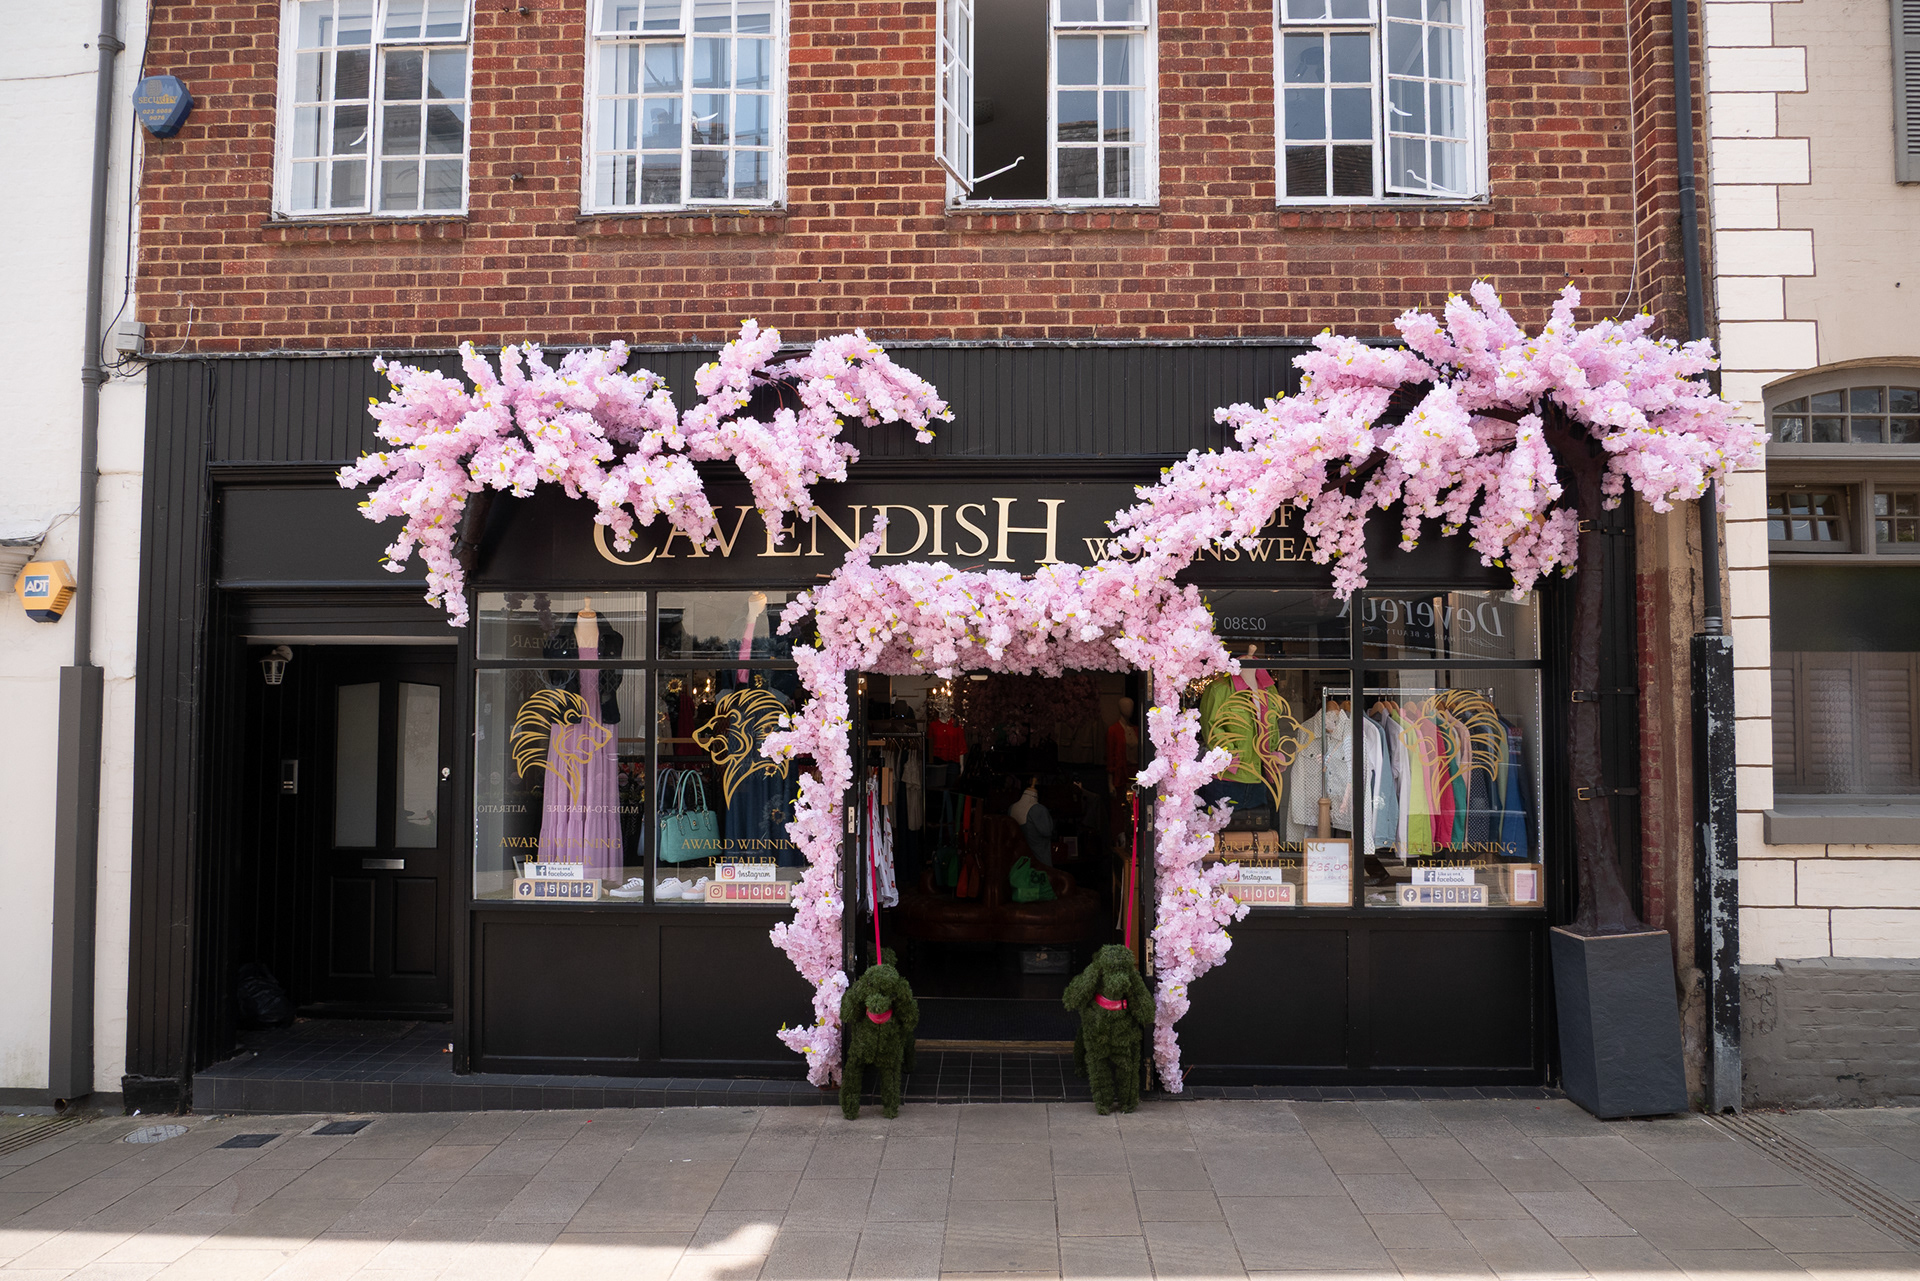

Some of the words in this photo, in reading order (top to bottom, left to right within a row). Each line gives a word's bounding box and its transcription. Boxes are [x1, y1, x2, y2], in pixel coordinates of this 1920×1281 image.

[593, 497, 1066, 566] CAVENDISH
[1082, 536, 1333, 563] WNSWEA
[24, 580, 49, 593] ADT
[499, 837, 551, 848] AWARD
[553, 838, 622, 849] WINNING
[681, 838, 735, 850] AWARD
[737, 838, 801, 850] WINNIN
[1254, 840, 1326, 853] WINNING
[1388, 841, 1444, 853] AWARD
[1446, 841, 1517, 853] WINNING
[525, 854, 594, 866] RETAILER
[708, 856, 779, 868] RETAILER
[1238, 859, 1298, 870] ETAILER
[1416, 859, 1489, 871] RETAILER
[1308, 861, 1349, 872] £35.00
[737, 870, 771, 880] Instagram
[1241, 873, 1273, 883] Instagram
